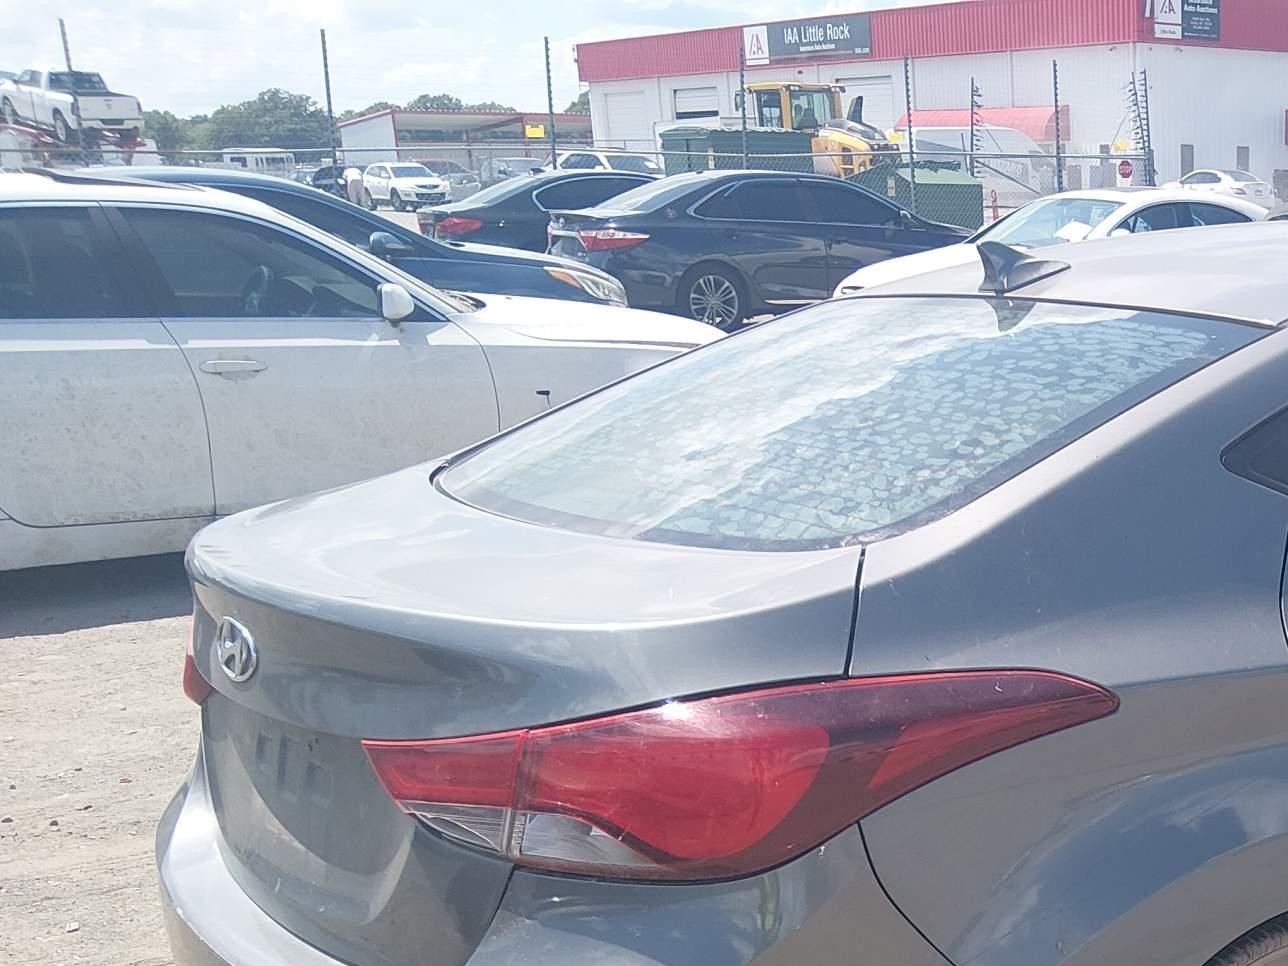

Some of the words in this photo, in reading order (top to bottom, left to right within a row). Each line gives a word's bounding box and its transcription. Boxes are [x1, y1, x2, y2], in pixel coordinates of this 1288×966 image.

[784, 28, 799, 44] IAA
[801, 25, 824, 43] Little
[826, 21, 850, 41] Rock
[1119, 165, 1133, 174] STOP
